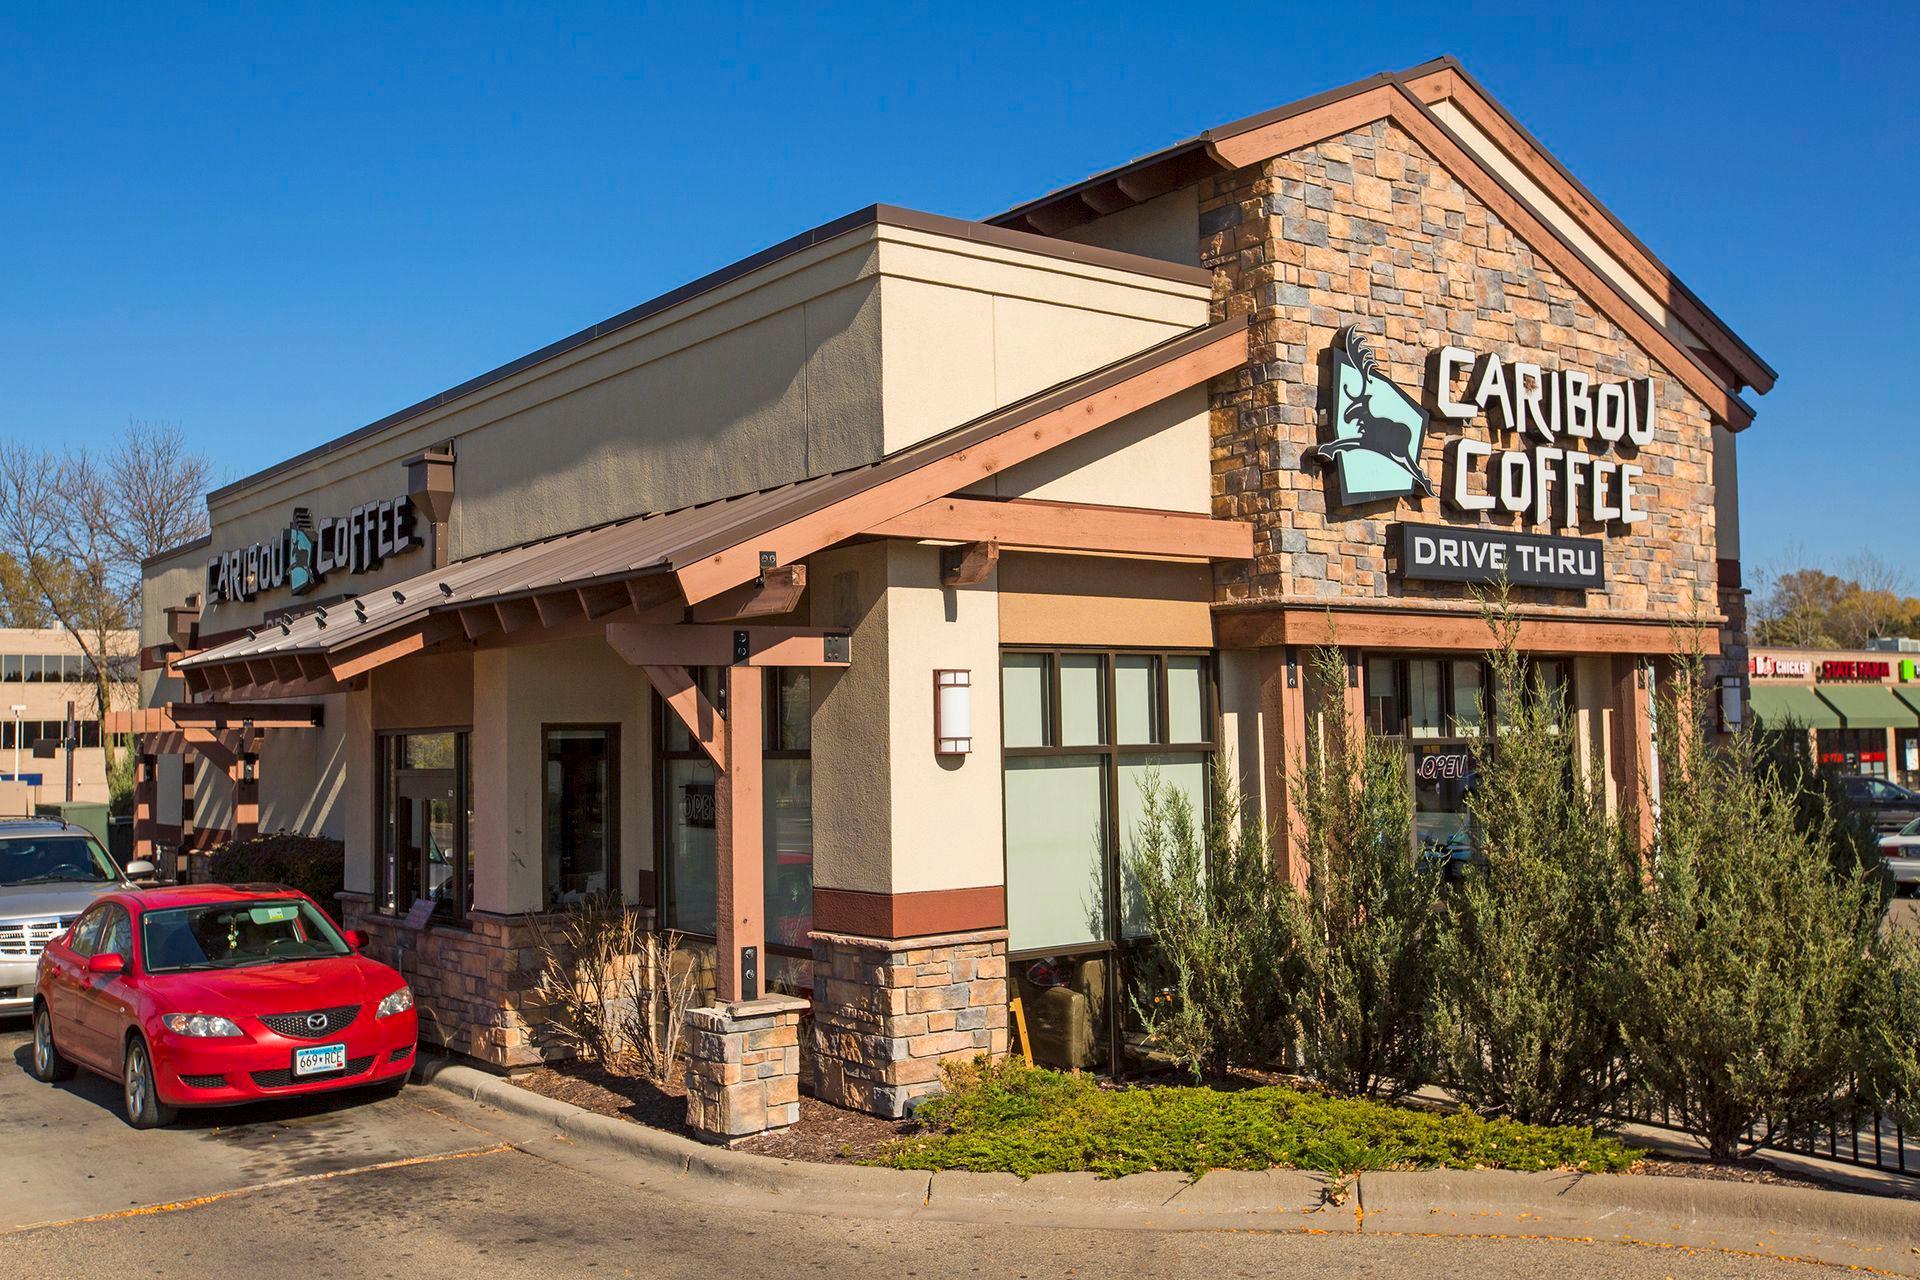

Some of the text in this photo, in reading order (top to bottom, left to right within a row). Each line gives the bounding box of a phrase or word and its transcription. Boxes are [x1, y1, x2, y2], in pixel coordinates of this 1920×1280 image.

[1437, 346, 1655, 446] CARIBOU
[1455, 438, 1649, 529] COFFEE
[206, 495, 411, 605] CARIBOU COFFEE
[1414, 536, 1597, 576] DRIVE THRU
[1775, 660, 1811, 674] CHICKEN
[1823, 660, 1890, 679] STATE FARM
[1421, 754, 1468, 779] OPEN
[300, 1054, 318, 1068] 669
